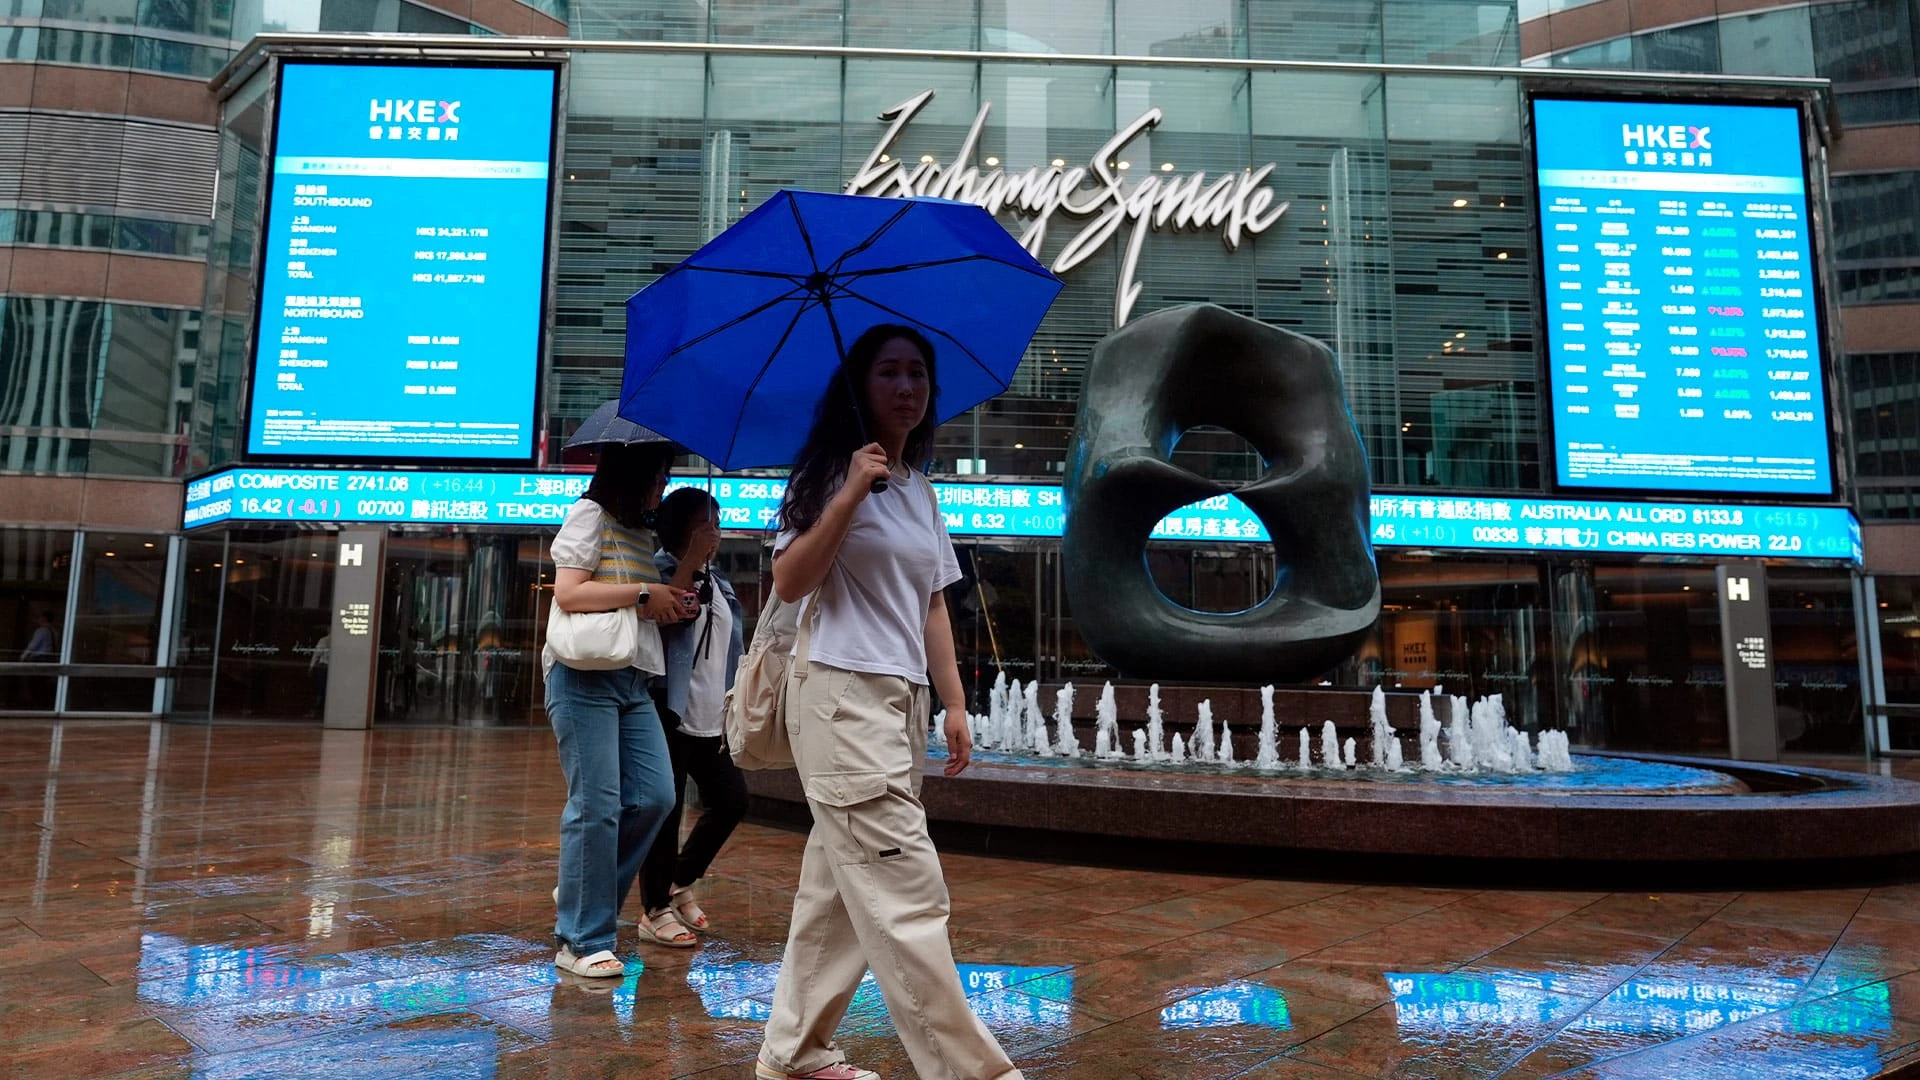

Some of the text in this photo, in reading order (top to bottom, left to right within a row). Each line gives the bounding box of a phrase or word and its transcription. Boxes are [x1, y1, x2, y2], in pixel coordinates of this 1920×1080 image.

[370, 100, 460, 123] HKEX
[1623, 124, 1711, 149] HKEX
[294, 197, 372, 207] SOUTHBOUND
[1050, 105, 1290, 330] Square
[284, 309, 363, 318] NORTHBOUND
[238, 474, 339, 489] COMPOSITE
[241, 498, 283, 513] 16.42
[357, 500, 405, 515] 00700
[411, 499, 489, 520] 騰訊控股
[1520, 504, 1611, 521] AUSTRALIA
[1617, 508, 1646, 522] ALL
[1650, 508, 1686, 523] ORD
[1693, 509, 1743, 525] 8133.8
[971, 514, 1005, 529] 6.32
[1473, 527, 1519, 542] 00836
[1525, 526, 1599, 548] 華潤電力
[1607, 531, 1658, 547] CHINA
[1661, 532, 1696, 547] RES
[1699, 533, 1761, 549] POWER
[1768, 534, 1802, 551] 22.0
[340, 544, 363, 566] H
[1727, 578, 1750, 601] H
